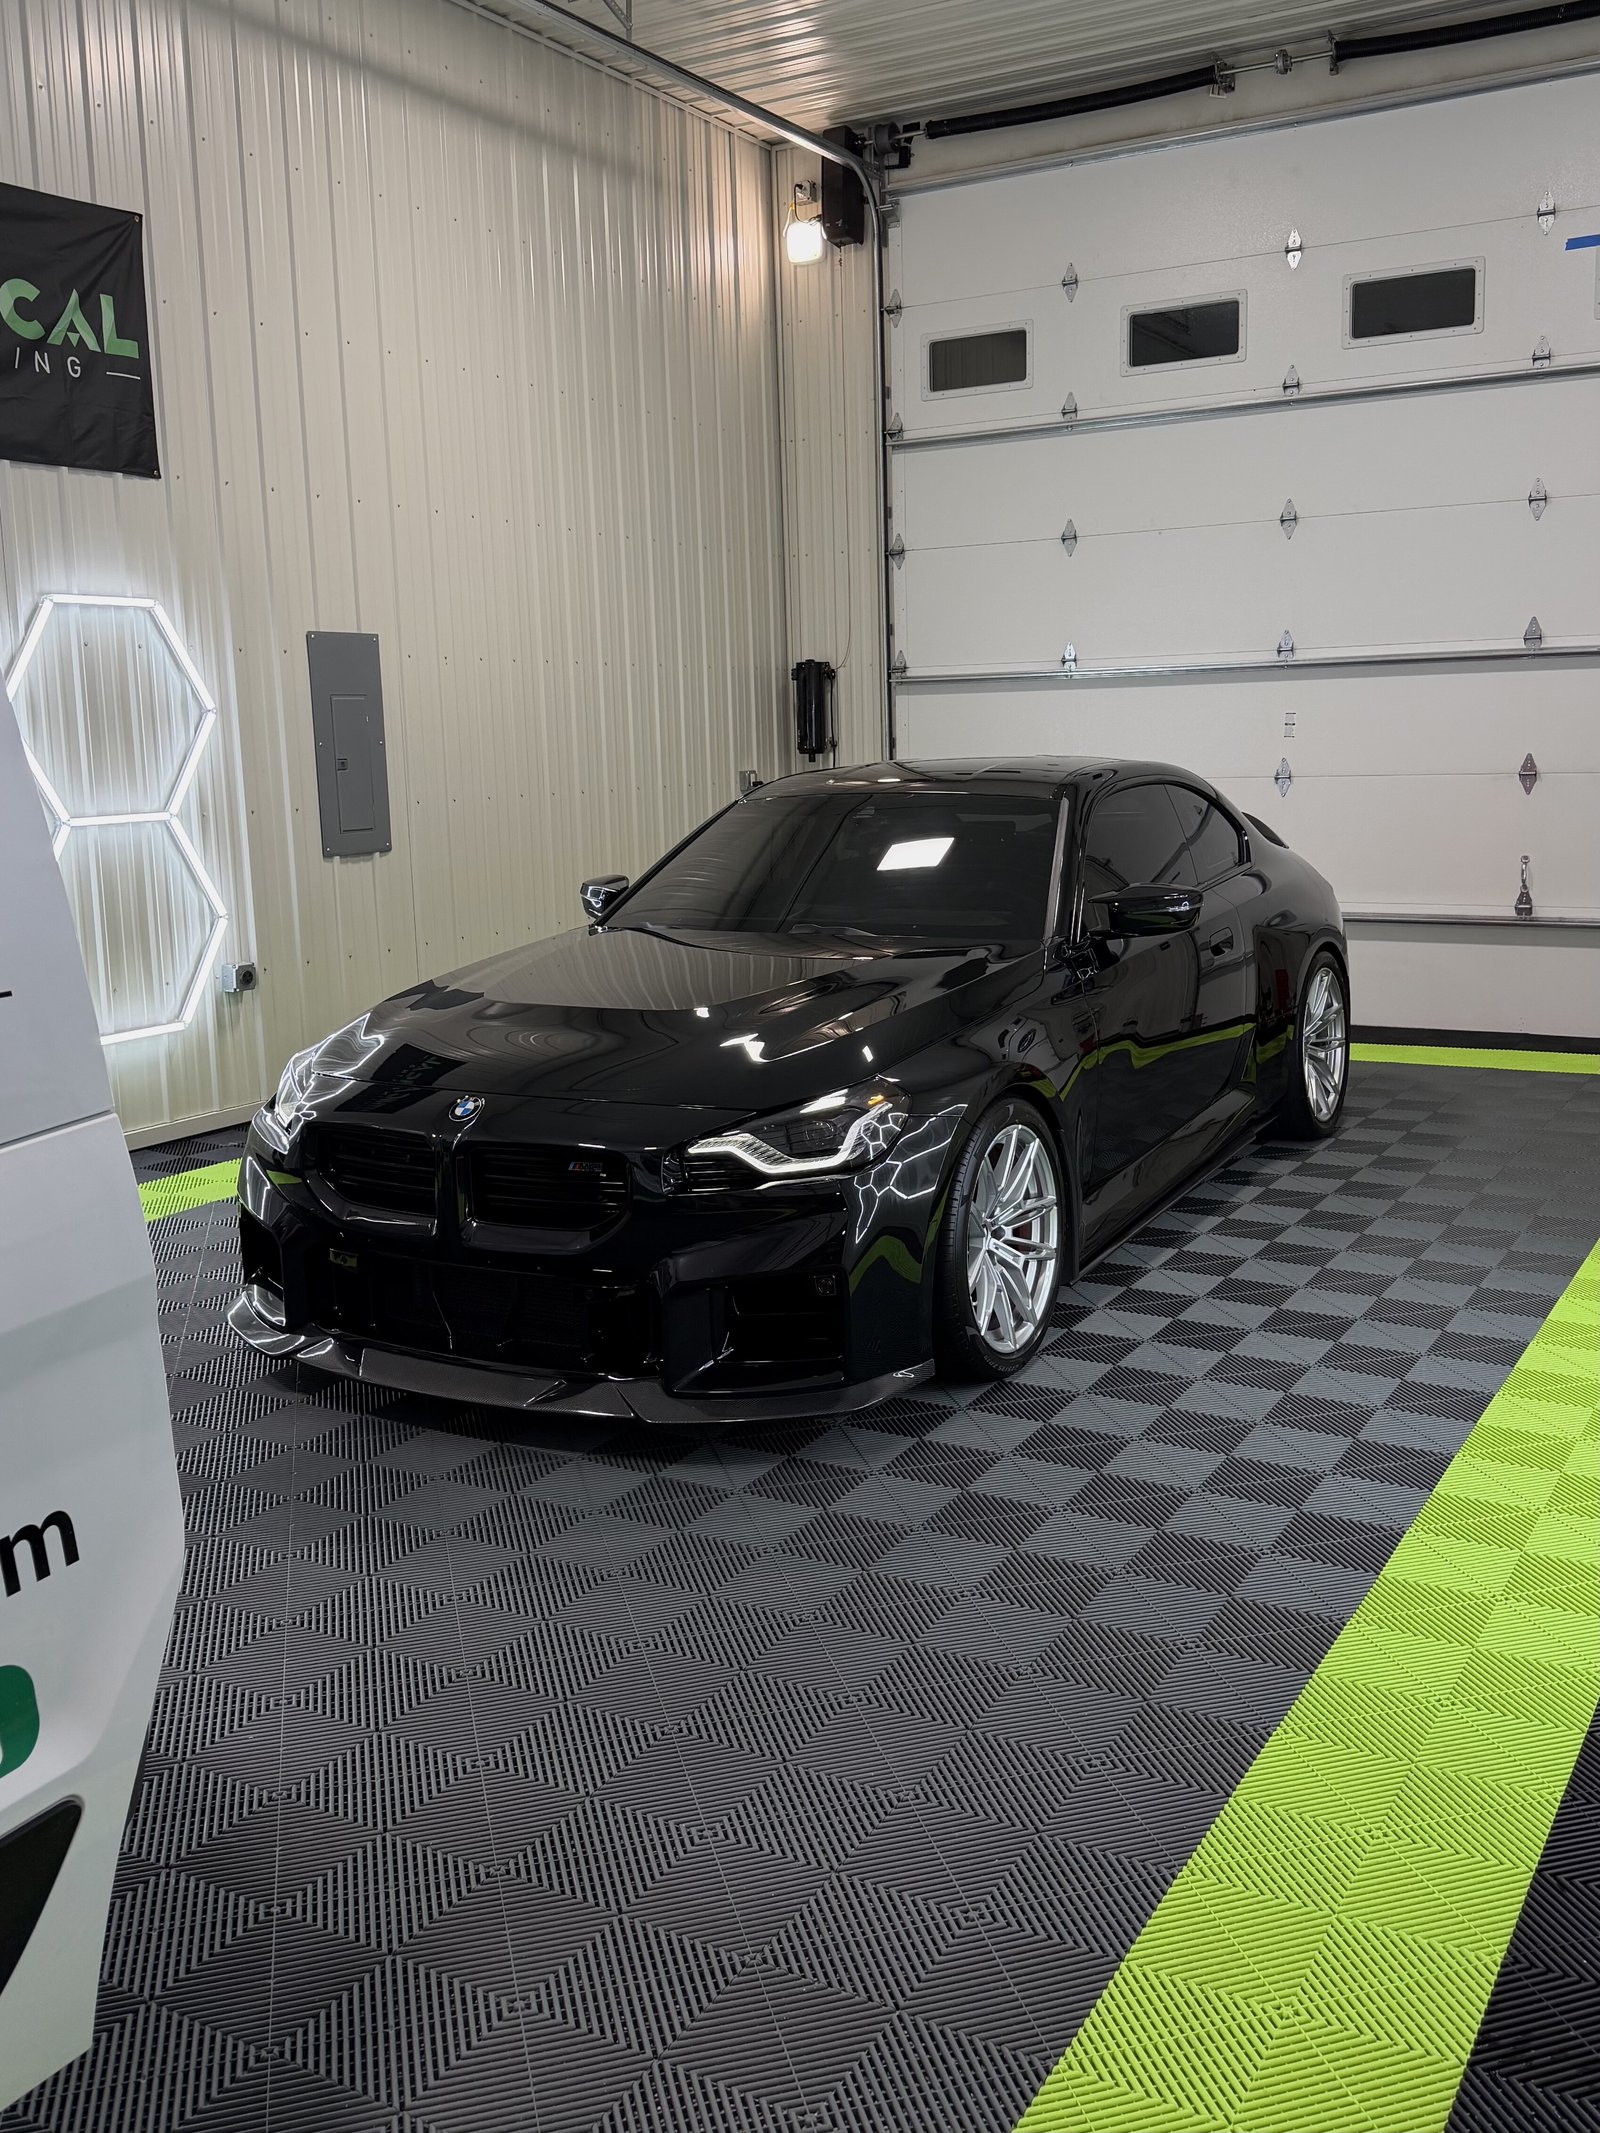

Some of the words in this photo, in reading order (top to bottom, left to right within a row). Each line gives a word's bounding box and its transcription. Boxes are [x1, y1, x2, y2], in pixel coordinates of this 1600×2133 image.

[0, 278, 140, 359] CAL
[14, 347, 82, 378] ING
[0, 1510, 80, 1598] m
